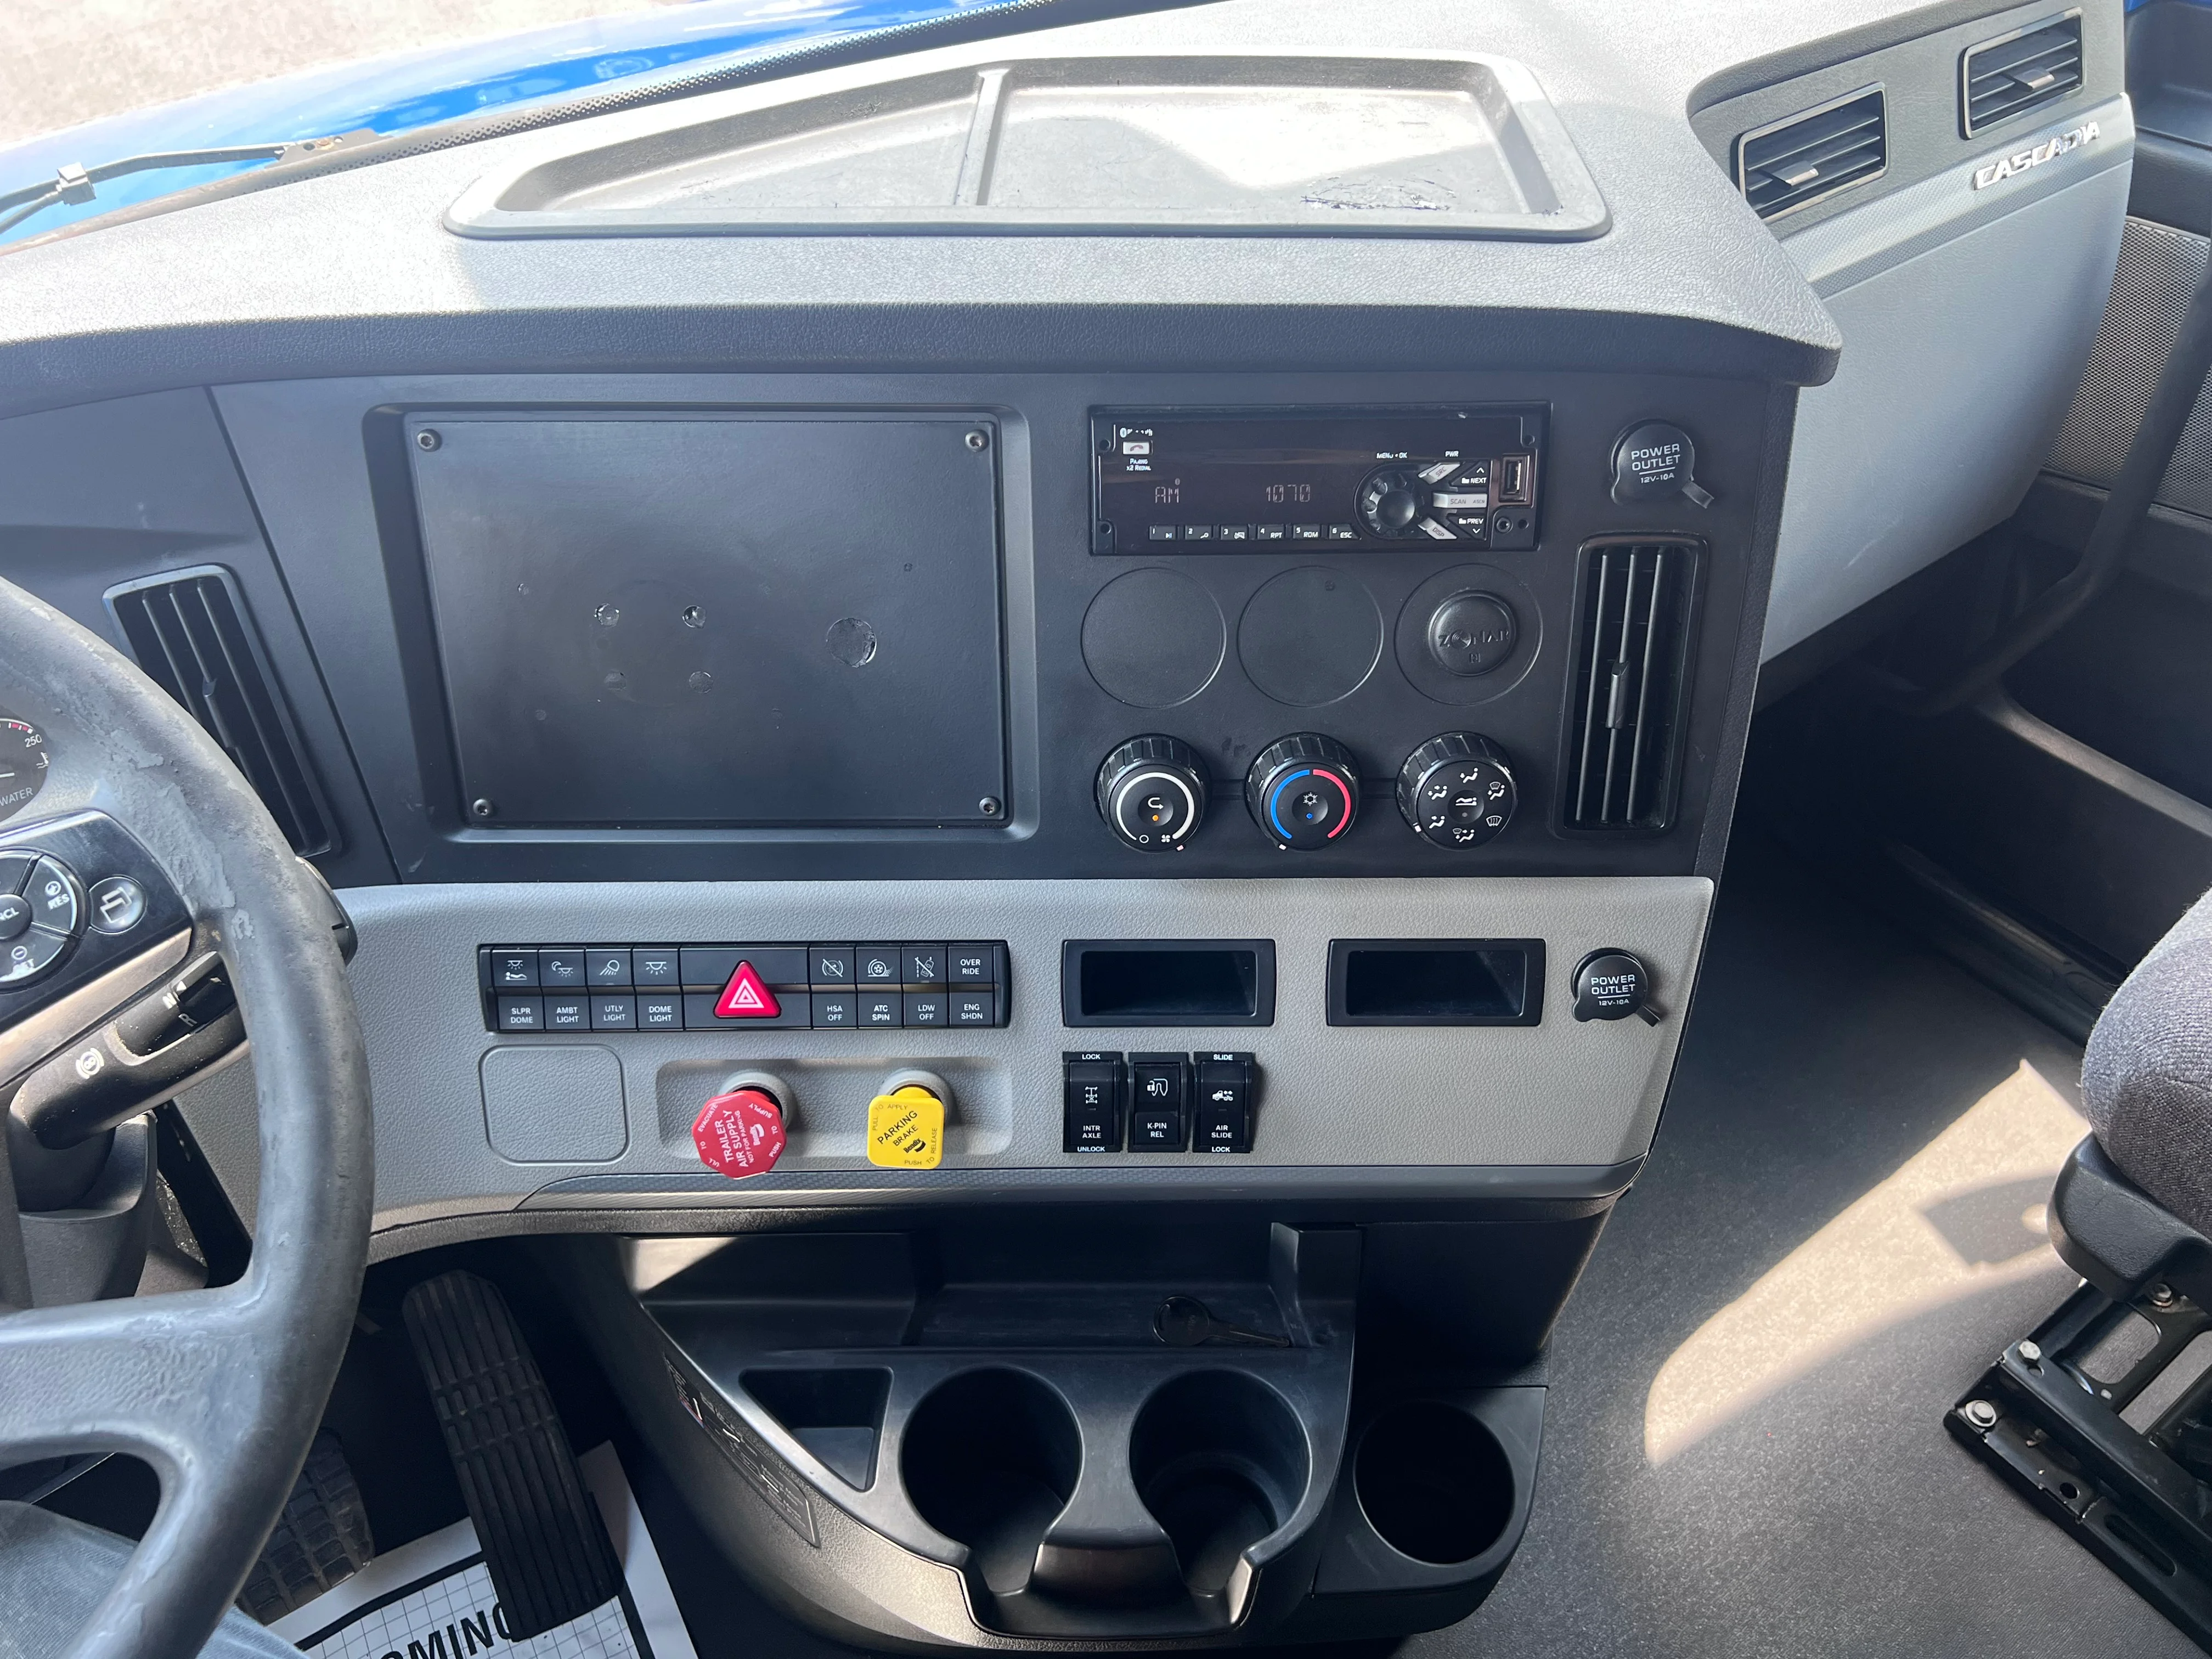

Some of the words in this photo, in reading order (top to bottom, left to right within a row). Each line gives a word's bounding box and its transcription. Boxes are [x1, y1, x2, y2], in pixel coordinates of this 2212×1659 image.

[1631, 443, 1680, 460] POWER
[1632, 454, 1681, 471] OUTLET
[1435, 466, 1447, 477] SRC
[1640, 472, 1675, 483] 12V-10A
[1155, 486, 1179, 504] AM
[1266, 484, 1311, 503] 1070
[1432, 527, 1444, 537] DISP
[25, 734, 42, 748] 250
[0, 787, 33, 806] WATER
[1591, 974, 1635, 985] POWER
[1592, 984, 1635, 995] OUTLET
[178, 1013, 198, 1028] R
[697, 1103, 718, 1132] EVACUATE
[748, 1103, 772, 1119] SUPPLY
[723, 1110, 742, 1149] SUPPLY
[734, 1110, 747, 1137] PARKING
[771, 1125, 778, 1135] TO
[877, 1110, 918, 1144] PARKING
[715, 1119, 734, 1163] TRAILER
[742, 1137, 751, 1150] FOR
[893, 1125, 918, 1146] BRAKE
[699, 1141, 707, 1150] TO
[769, 1142, 782, 1158] PUSH
[736, 1150, 749, 1167] AIR
[746, 1151, 754, 1163] NOT
